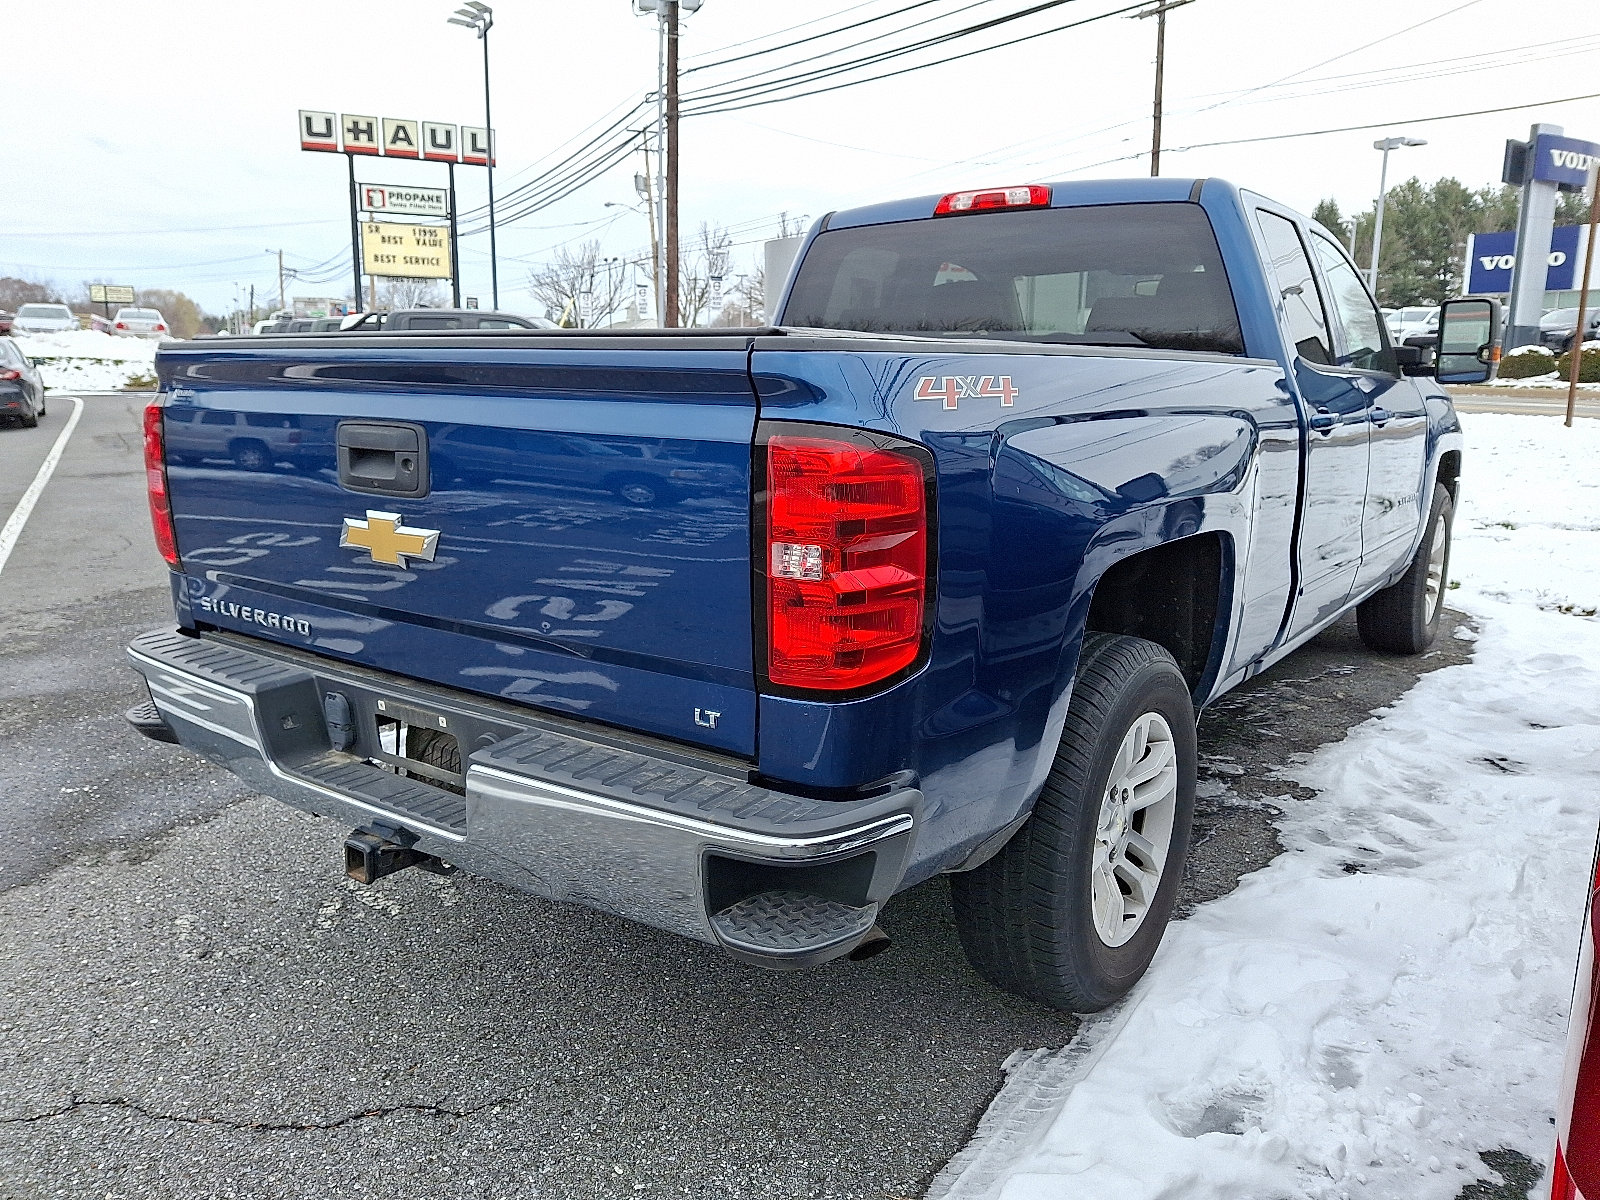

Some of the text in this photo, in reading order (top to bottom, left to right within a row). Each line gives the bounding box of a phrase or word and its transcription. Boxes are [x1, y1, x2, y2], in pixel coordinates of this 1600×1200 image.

[388, 192, 443, 204] PROPANE
[381, 235, 443, 248] BEST VALUE
[373, 254, 440, 266] BEST SERVICE
[1479, 251, 1567, 271] VOO
[200, 596, 312, 637] SILVERADO
[694, 707, 721, 729] LT
